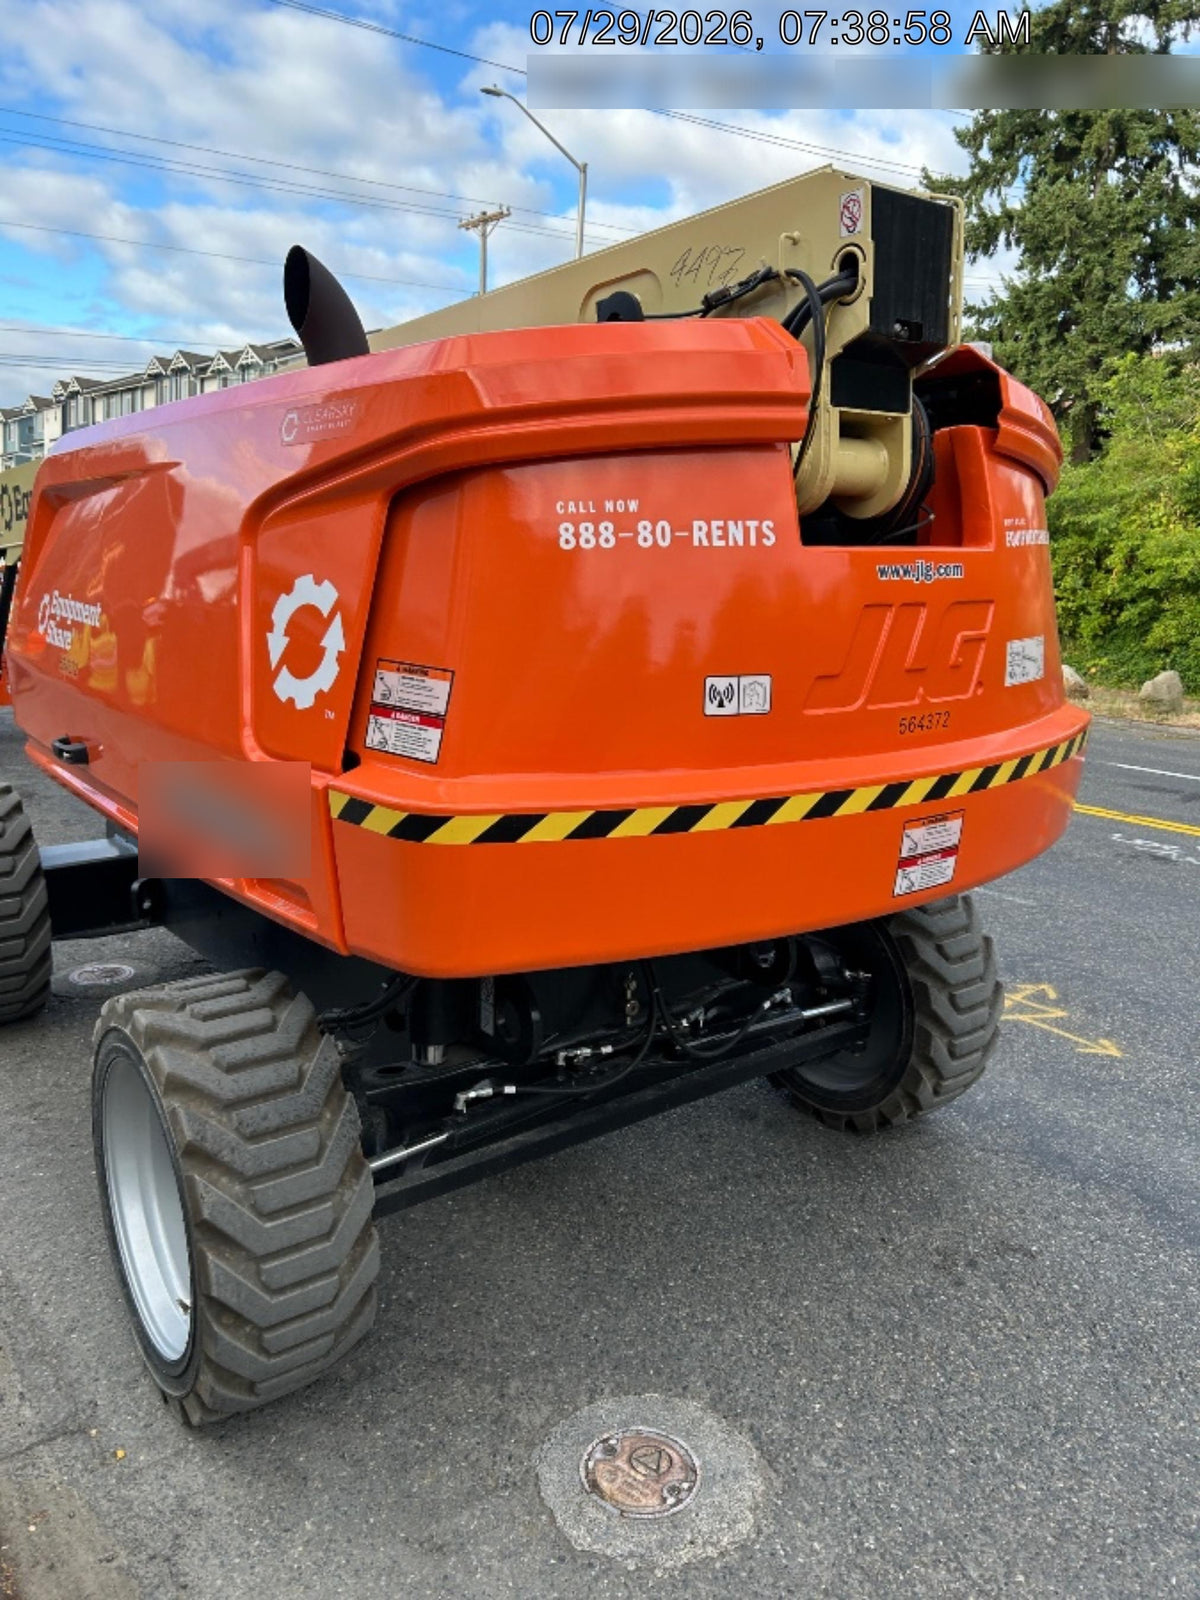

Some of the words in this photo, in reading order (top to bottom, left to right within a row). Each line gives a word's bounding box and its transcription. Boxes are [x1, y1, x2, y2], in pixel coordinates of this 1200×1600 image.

[556, 500, 597, 515] CALL
[604, 499, 640, 513] NOW
[558, 519, 777, 550] 888-80-RENTS
[876, 559, 964, 583] www.jlg.com
[802, 599, 995, 715] JLG
[899, 711, 951, 735] 564372
